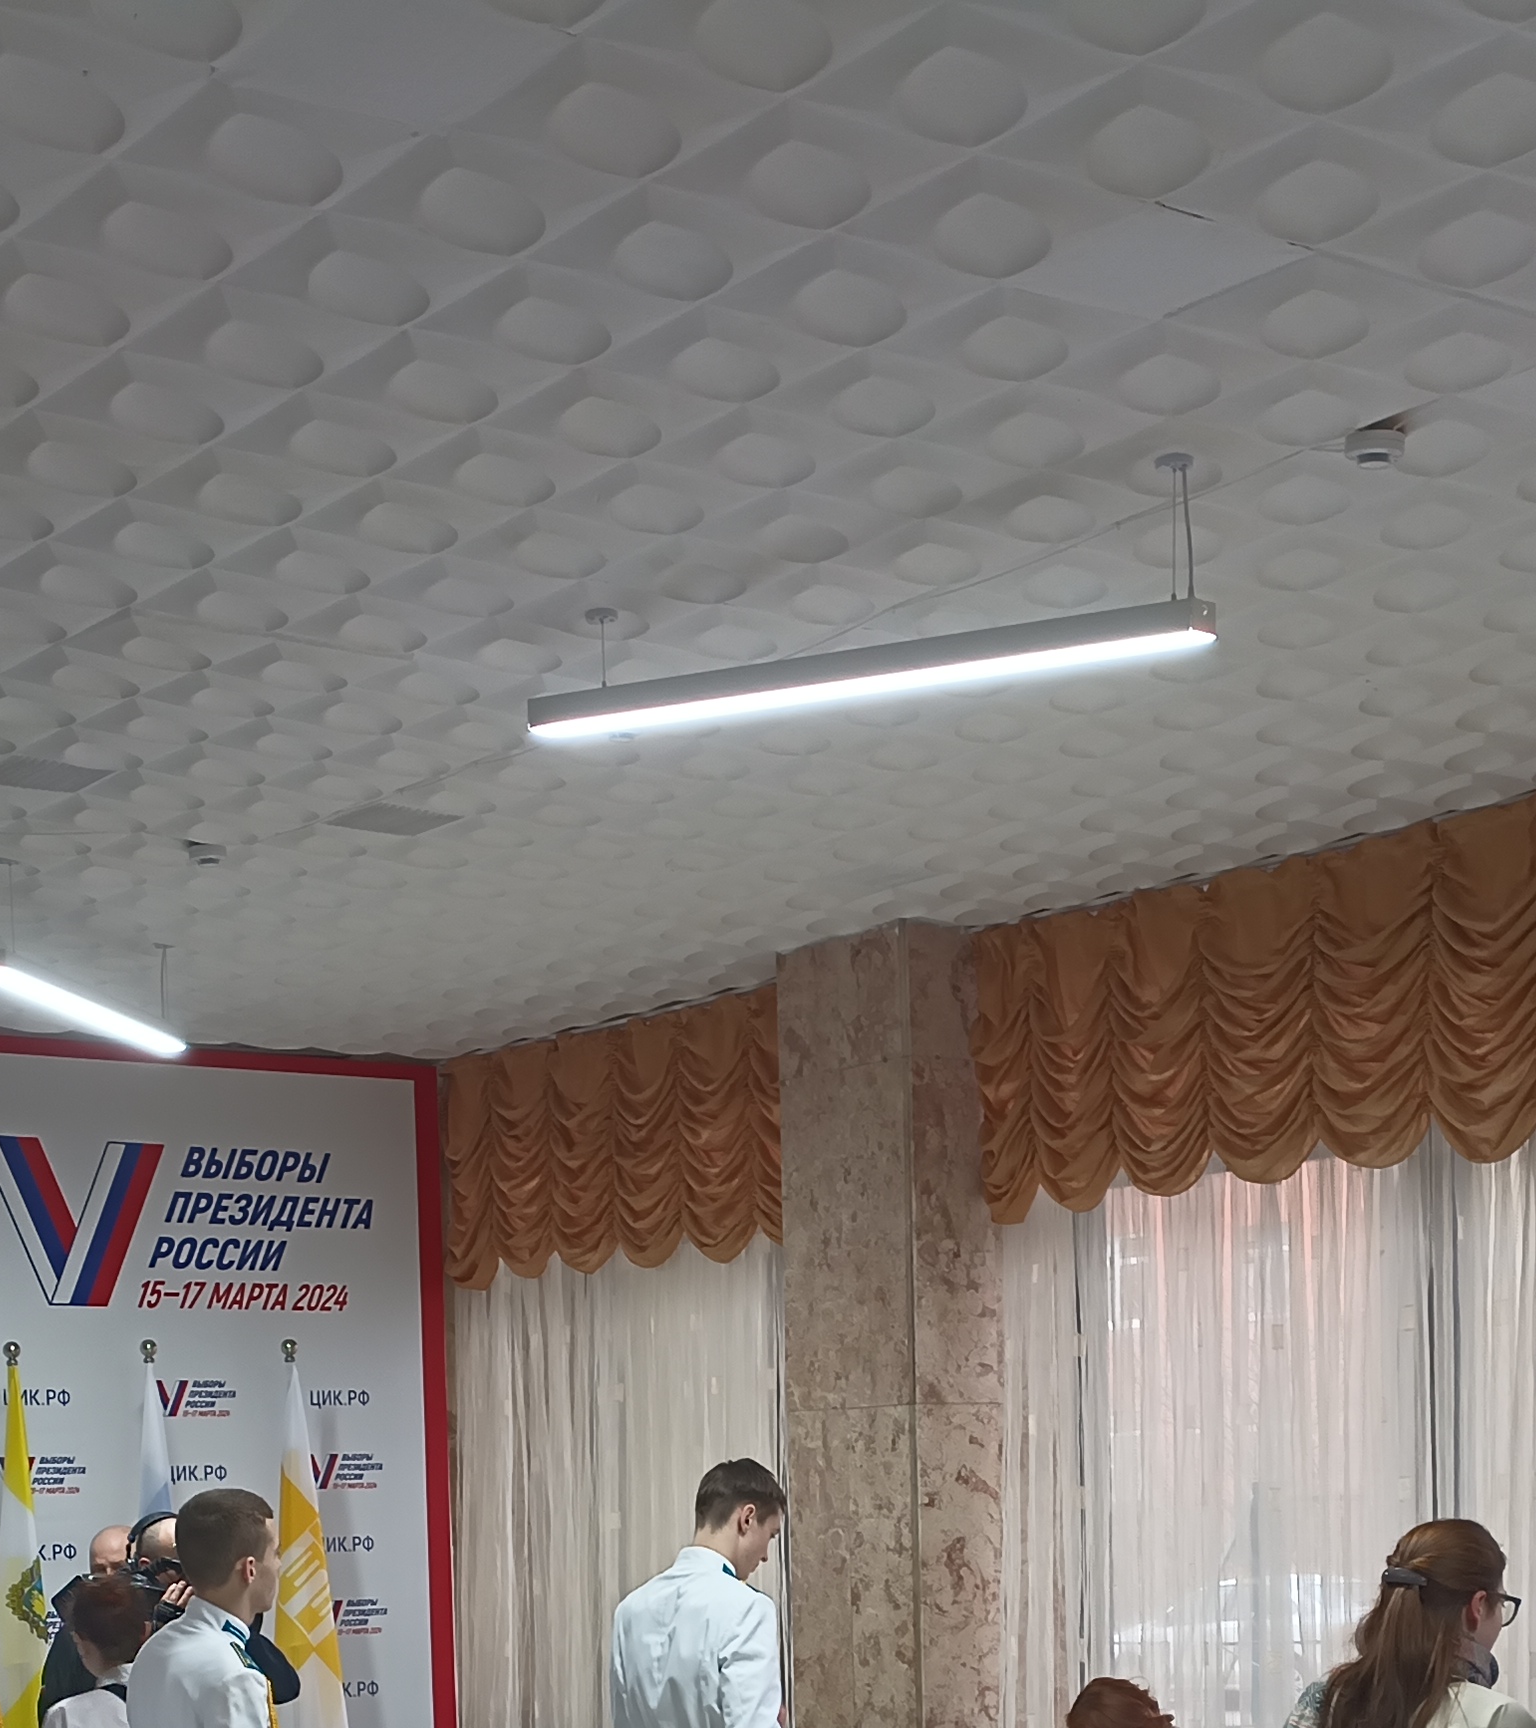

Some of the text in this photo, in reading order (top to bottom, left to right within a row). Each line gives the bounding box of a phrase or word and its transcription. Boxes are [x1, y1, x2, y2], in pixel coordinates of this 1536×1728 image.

[180, 1146, 331, 1183] ВЫБОРЫ
[165, 1192, 373, 1232] ПРЕЗИДЕНТА
[148, 1236, 287, 1271] РОССИИ
[138, 1280, 348, 1311] 15–17 МАРТА 2024
[310, 1390, 370, 1409] ЦИК.РФ
[322, 1536, 374, 1552] ИК.РФ
